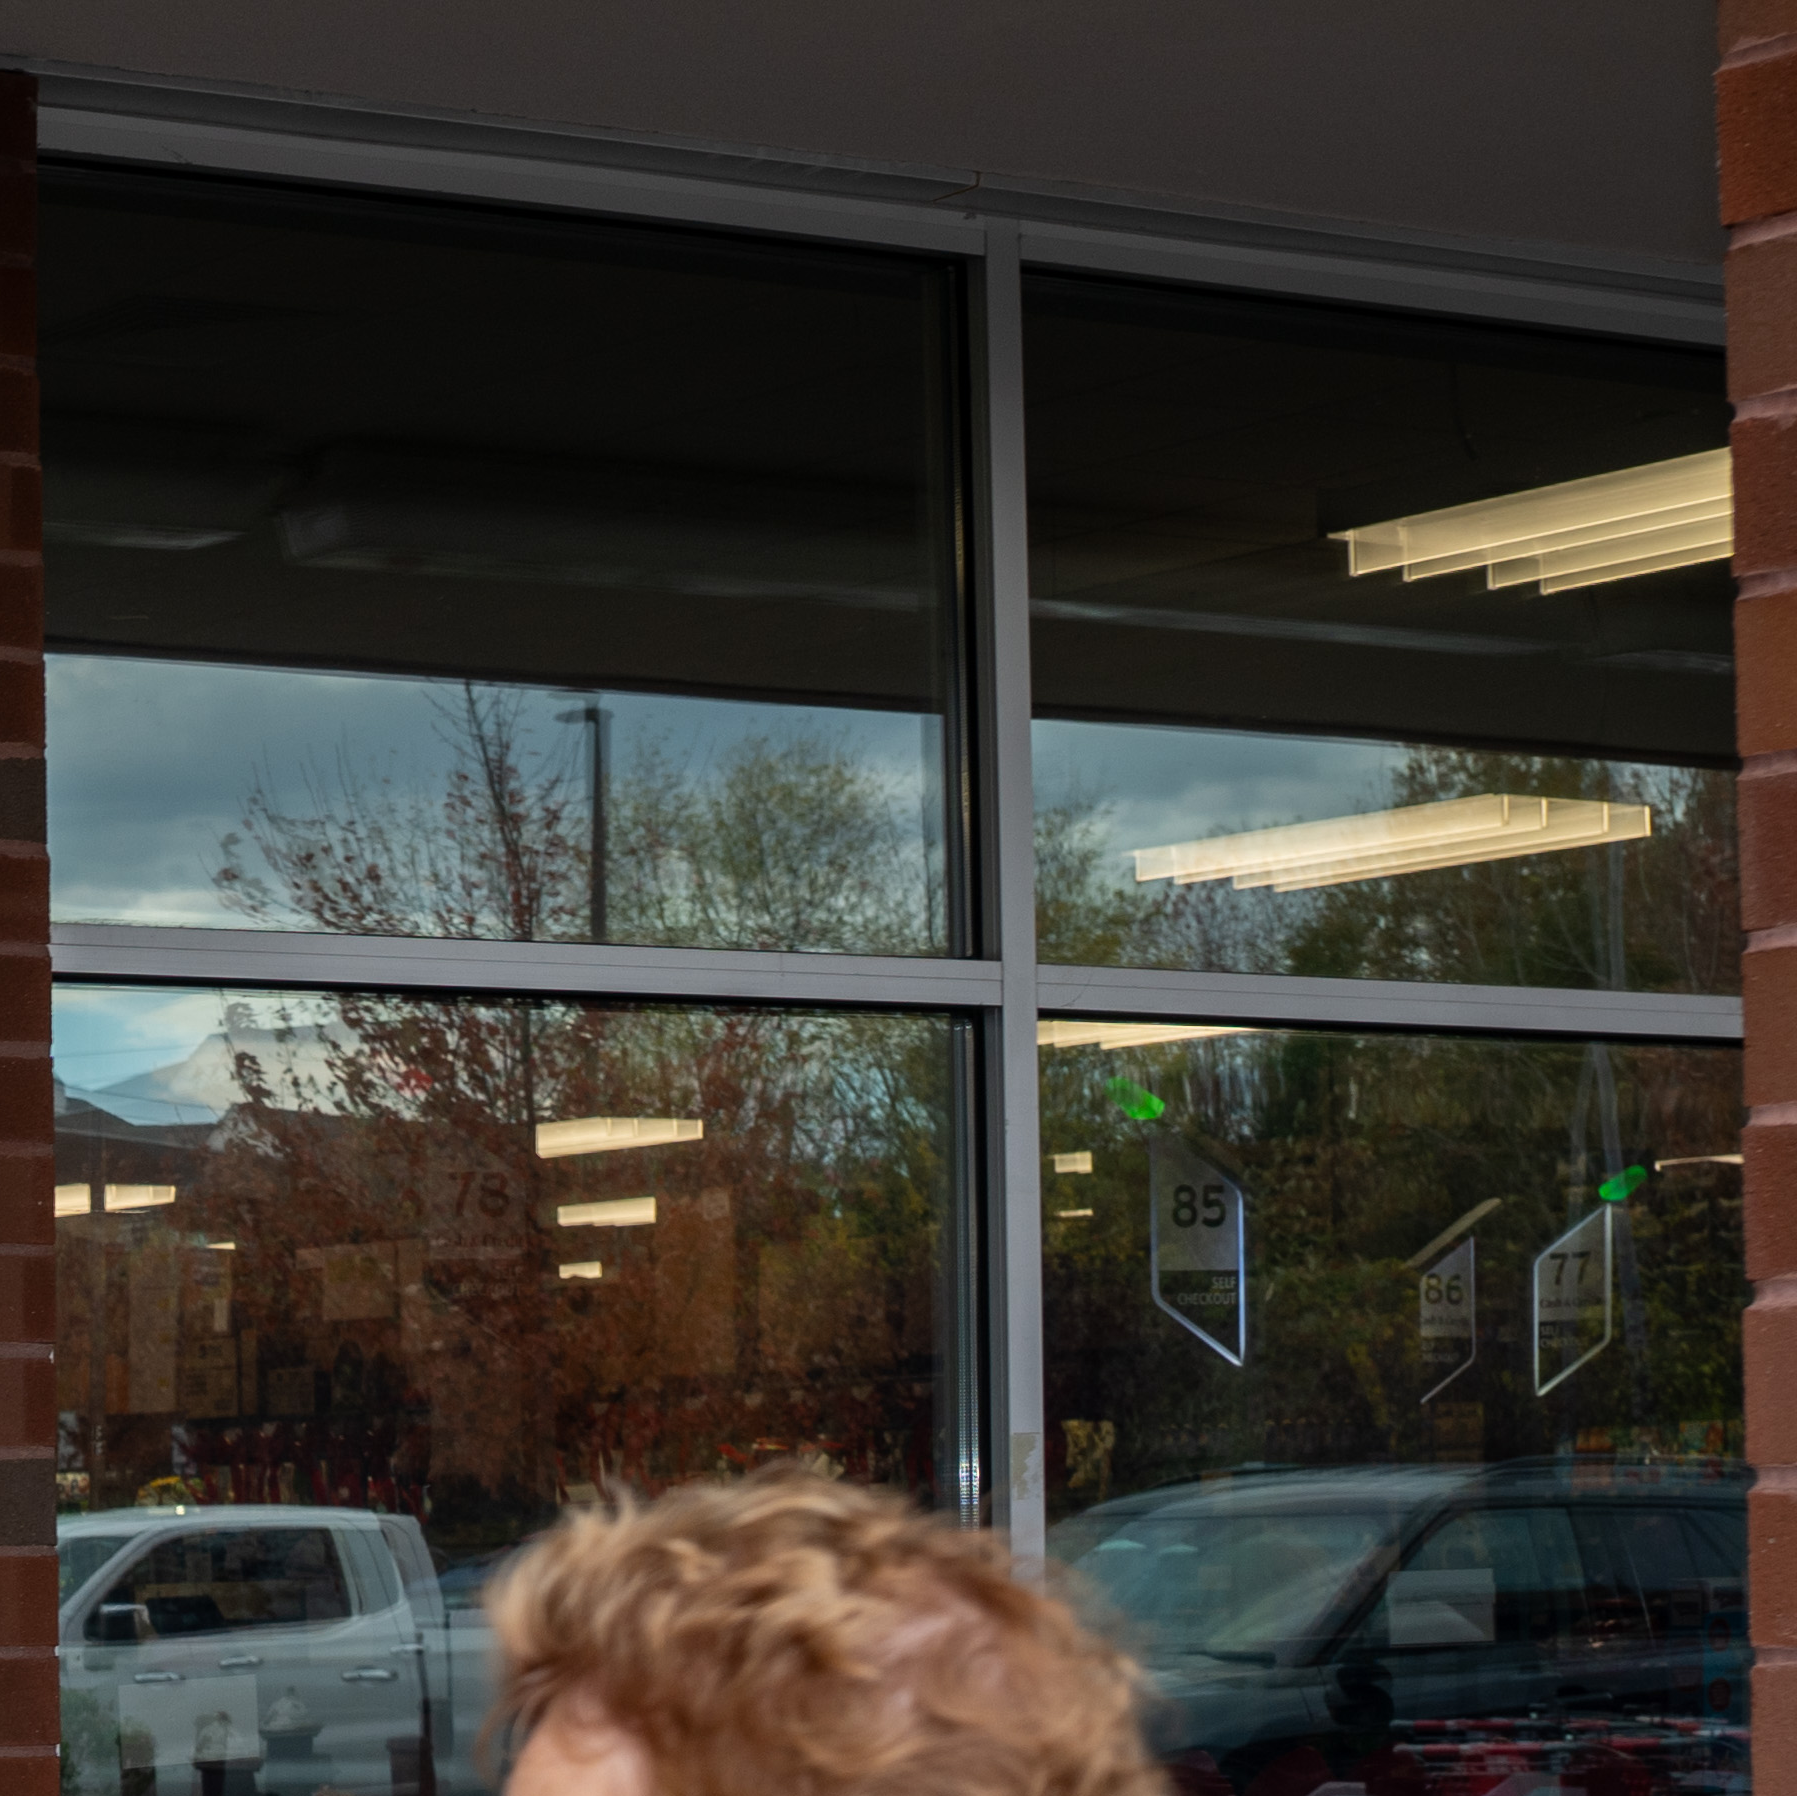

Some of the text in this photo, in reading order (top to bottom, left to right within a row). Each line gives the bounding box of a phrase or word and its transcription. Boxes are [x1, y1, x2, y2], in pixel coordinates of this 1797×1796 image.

[1172, 1184, 1226, 1228] 85
[1211, 1276, 1237, 1289] SELF
[1549, 1251, 1591, 1285] 77
[1177, 1292, 1237, 1305] CHECKOUT
[1425, 1273, 1463, 1306] 86
